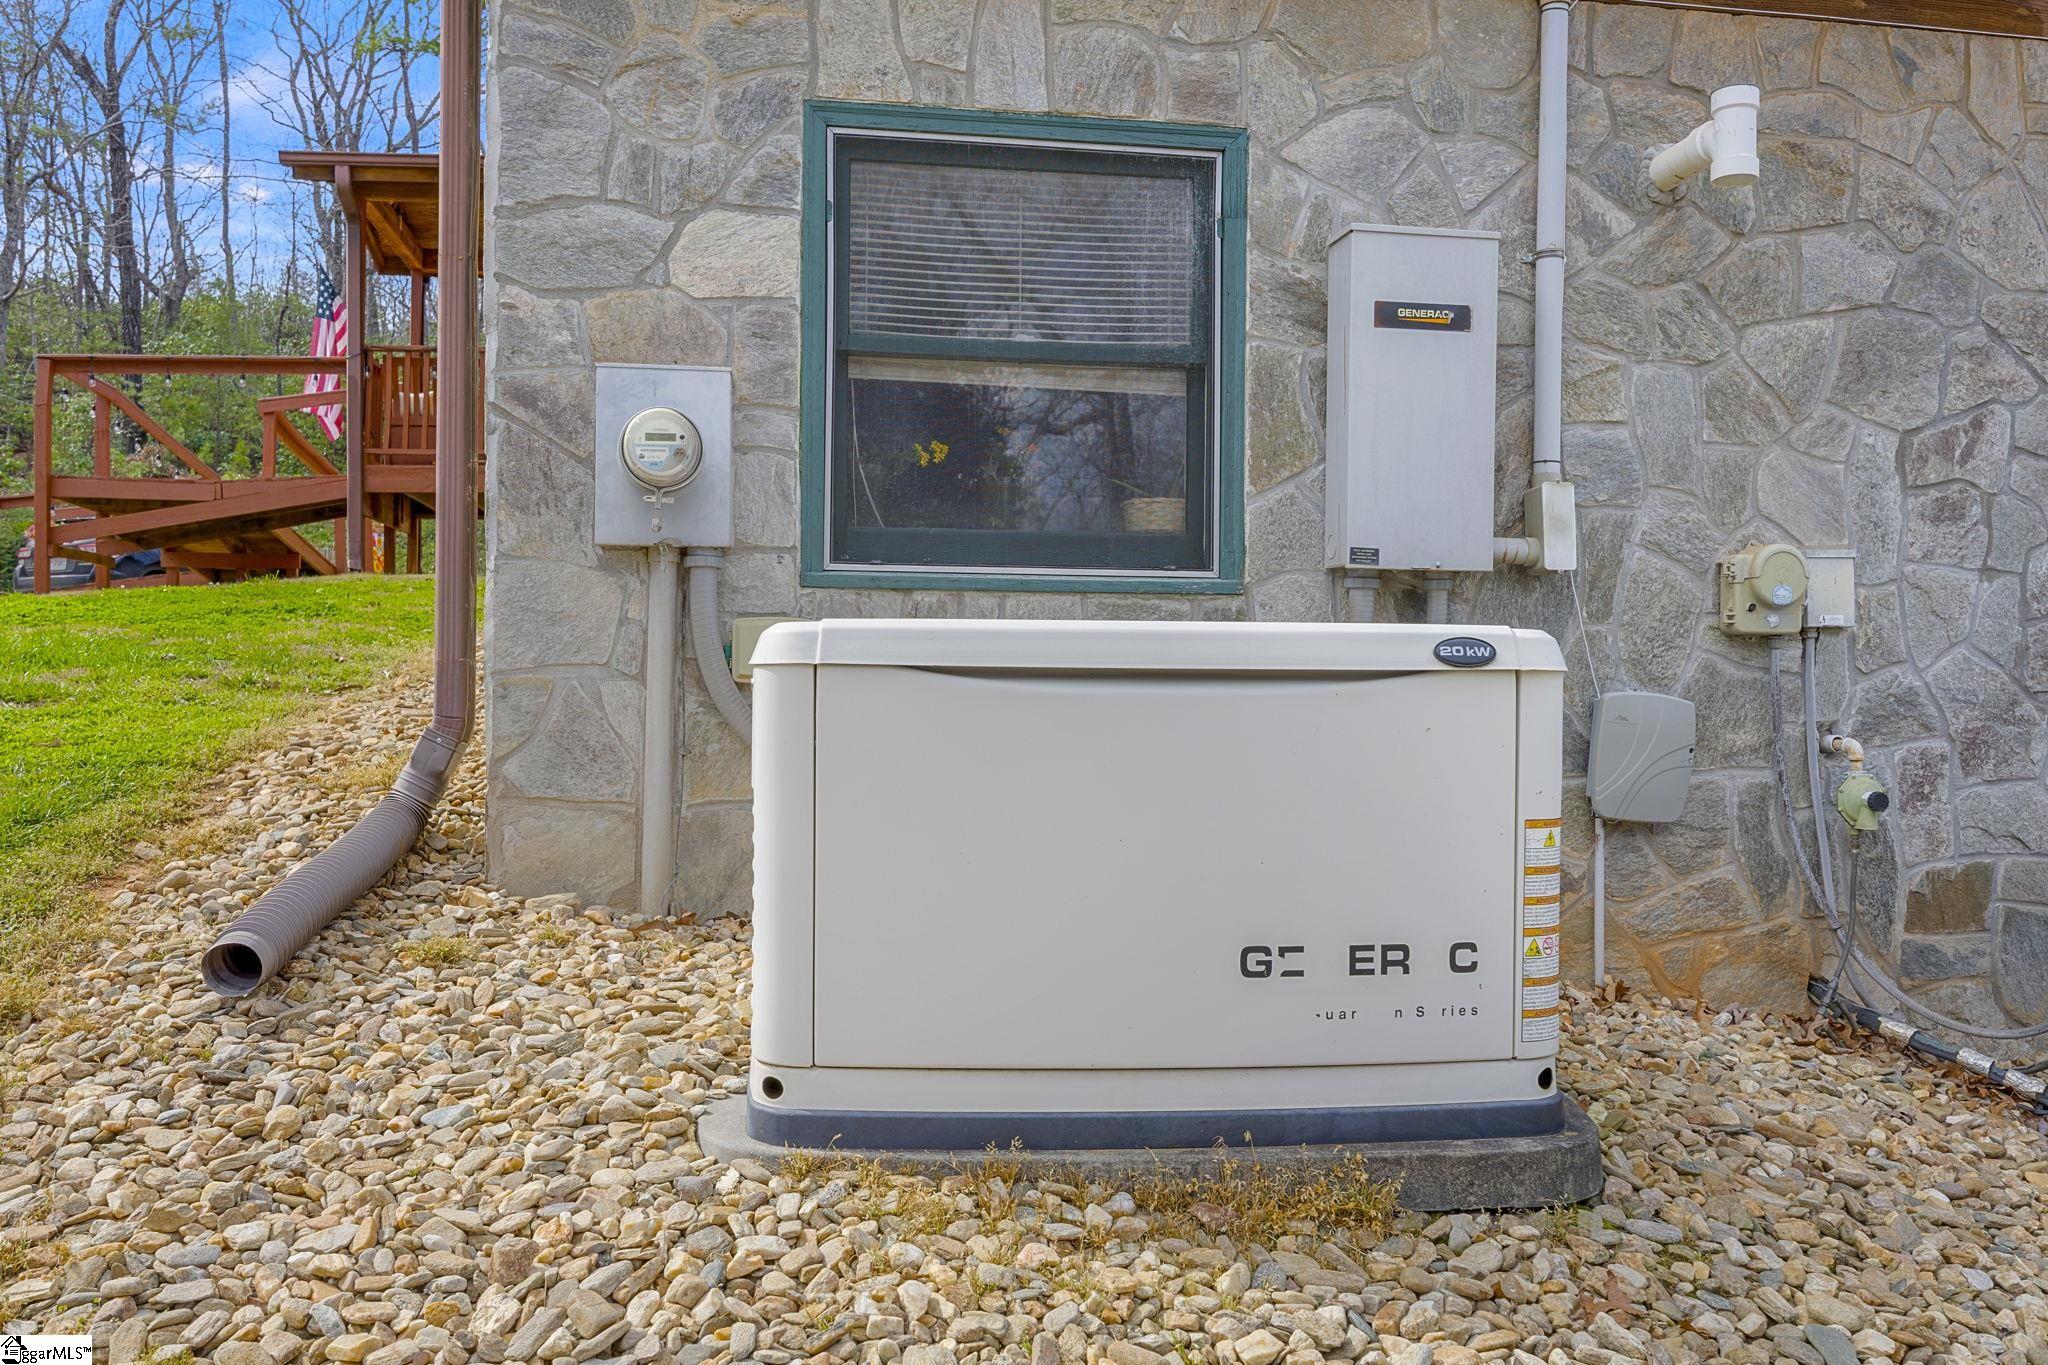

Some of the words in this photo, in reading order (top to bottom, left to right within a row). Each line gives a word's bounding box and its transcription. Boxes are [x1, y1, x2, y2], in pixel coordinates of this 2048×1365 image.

[1397, 308, 1453, 319] GENERAC
[1440, 646, 1463, 656] 20
[1466, 646, 1490, 657] kW
[1239, 942, 1479, 979] GEERC
[1415, 1004, 1479, 1019] Sries
